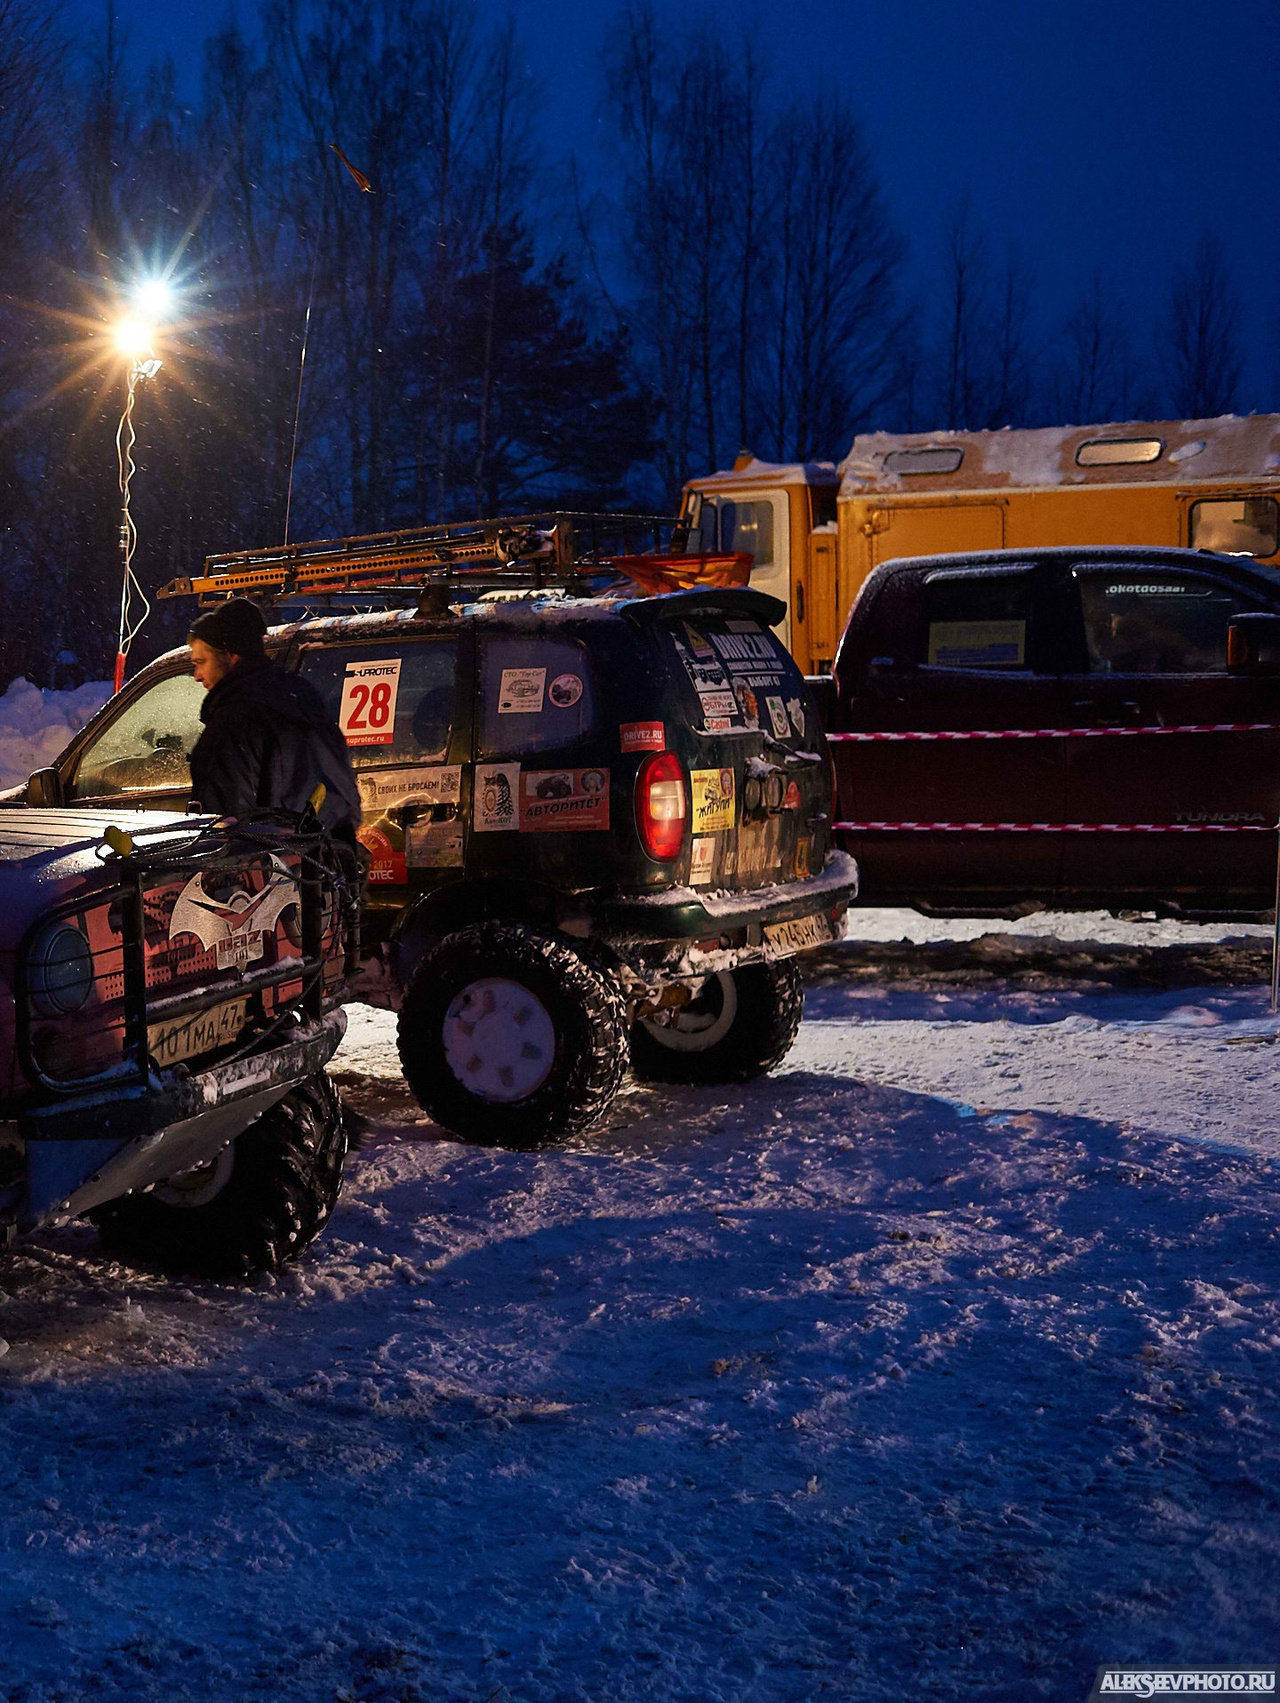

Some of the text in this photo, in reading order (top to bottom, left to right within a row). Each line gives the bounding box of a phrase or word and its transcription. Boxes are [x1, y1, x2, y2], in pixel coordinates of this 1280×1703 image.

[346, 682, 392, 730] 28
[377, 781, 439, 795] СВОИХ НЕ БРОСАЕМ!
[1172, 810, 1266, 821] TUNDRA
[368, 870, 394, 880] OTEC
[157, 1004, 238, 1059] 101МА 47
